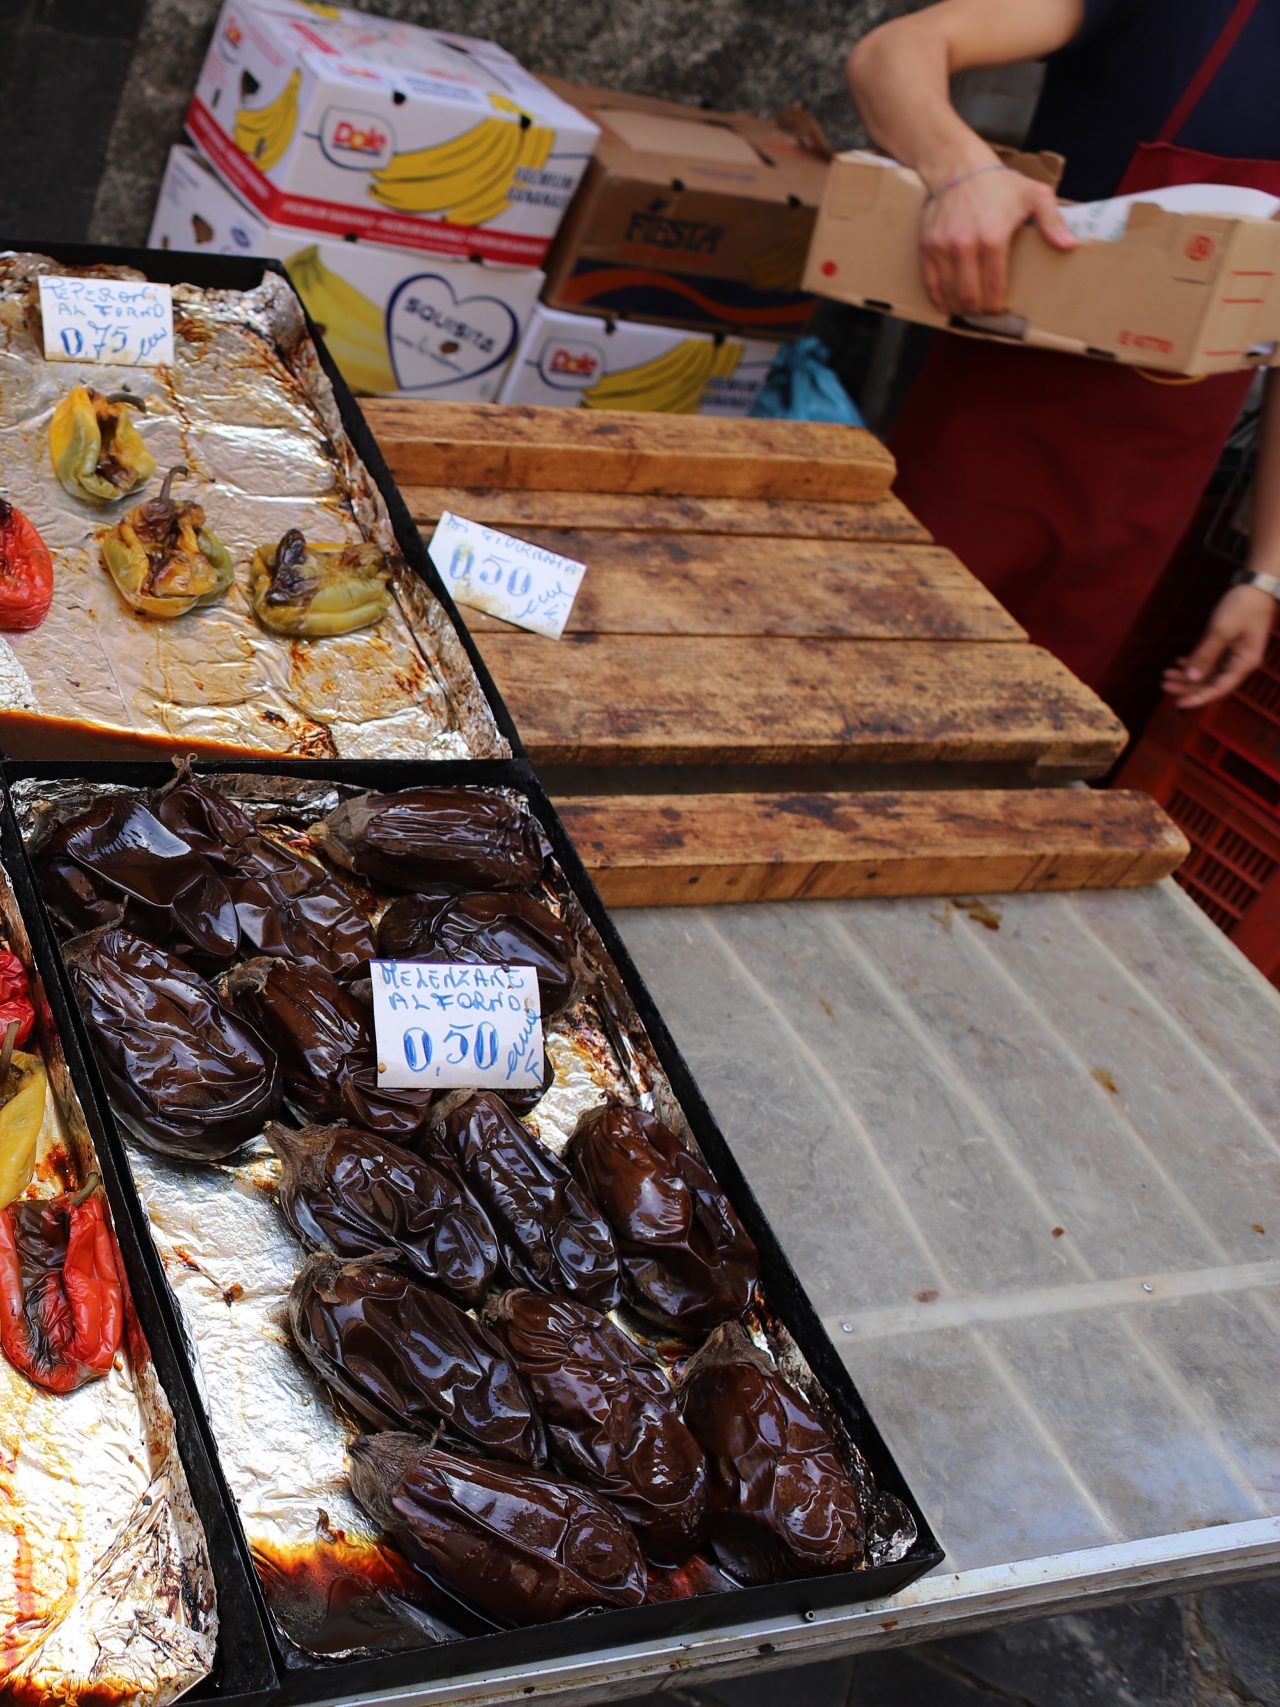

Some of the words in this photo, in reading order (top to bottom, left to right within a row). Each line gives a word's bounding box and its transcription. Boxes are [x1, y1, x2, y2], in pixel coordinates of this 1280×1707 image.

[332, 120, 388, 153] Dole
[625, 211, 727, 254] FIESTA
[550, 349, 599, 375] Dole
[379, 963, 525, 990] MELENZANE
[389, 991, 430, 1011] AL
[431, 992, 522, 1012] FORNO
[403, 1020, 499, 1077] 0,50
